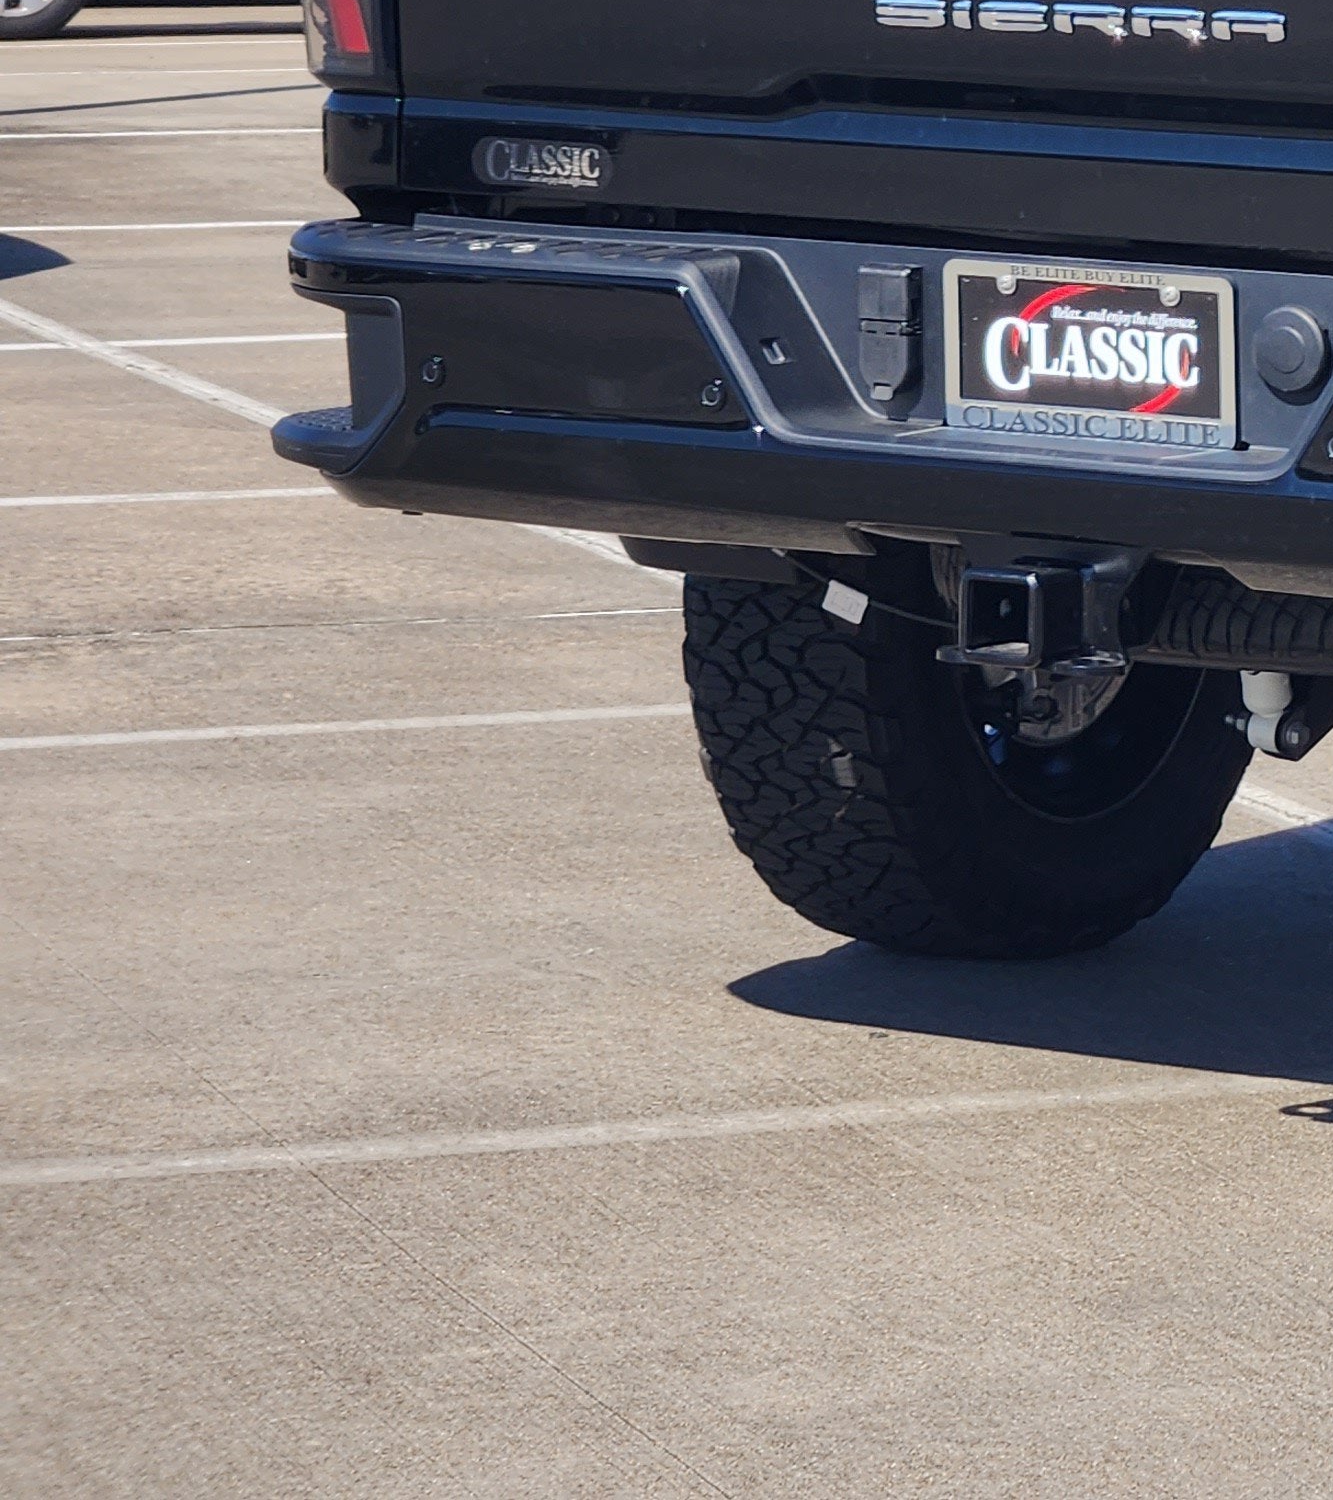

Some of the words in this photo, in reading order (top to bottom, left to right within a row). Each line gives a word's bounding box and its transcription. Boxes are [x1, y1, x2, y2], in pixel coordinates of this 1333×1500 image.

[486, 140, 600, 181] CLASSIC
[1011, 264, 1030, 277] BE
[1035, 267, 1082, 280] ELITE
[1085, 270, 1116, 283] BUY
[1120, 272, 1166, 286] ELITE
[984, 316, 1200, 392] CLASSIC
[962, 404, 1108, 440] CLASSIC
[1116, 416, 1222, 447] ELITE
